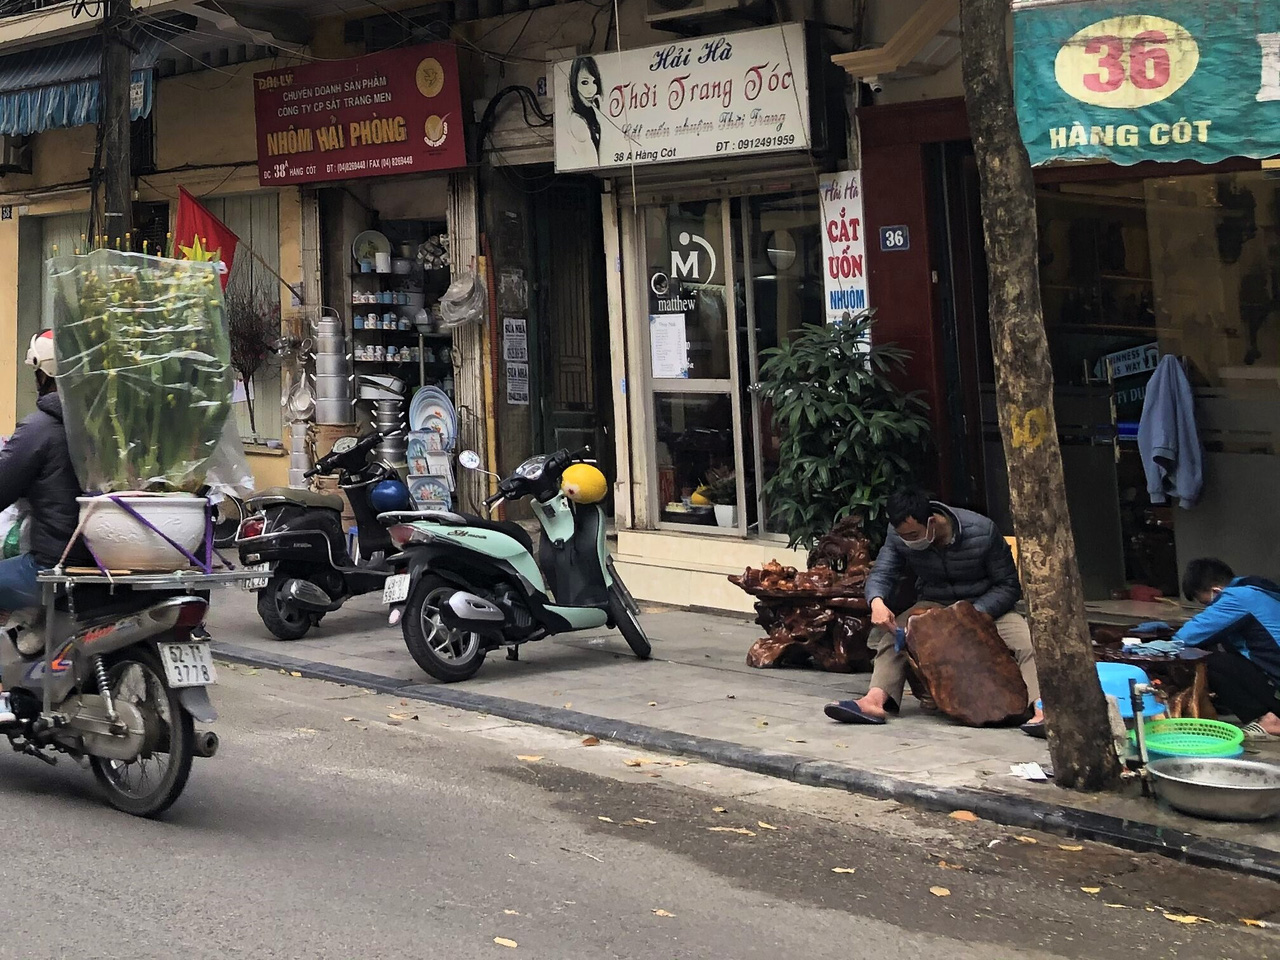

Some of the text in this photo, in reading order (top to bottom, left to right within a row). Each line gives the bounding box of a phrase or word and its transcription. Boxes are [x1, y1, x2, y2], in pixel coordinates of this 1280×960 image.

[649, 37, 733, 72] Hải Hà
[1082, 30, 1171, 93] 36
[315, 84, 341, 97] DOANH
[609, 61, 794, 119] Thời Trang Tóc
[302, 103, 312, 114] TY
[314, 101, 324, 112] CP
[373, 92, 392, 104] MEN
[267, 112, 408, 156] NHÔM HẢI PHÒNG
[737, 134, 795, 150] 0912491959
[1050, 117, 1212, 149] HÀNG CÓT
[369, 159, 380, 169] FAX
[635, 149, 657, 162] Hàng
[885, 230, 904, 247] 36
[671, 251, 699, 278] M
[828, 244, 863, 279] UỐN
[658, 295, 696, 312] matthew
[830, 285, 865, 314] NHUỘM
[174, 664, 210, 682] 3778
